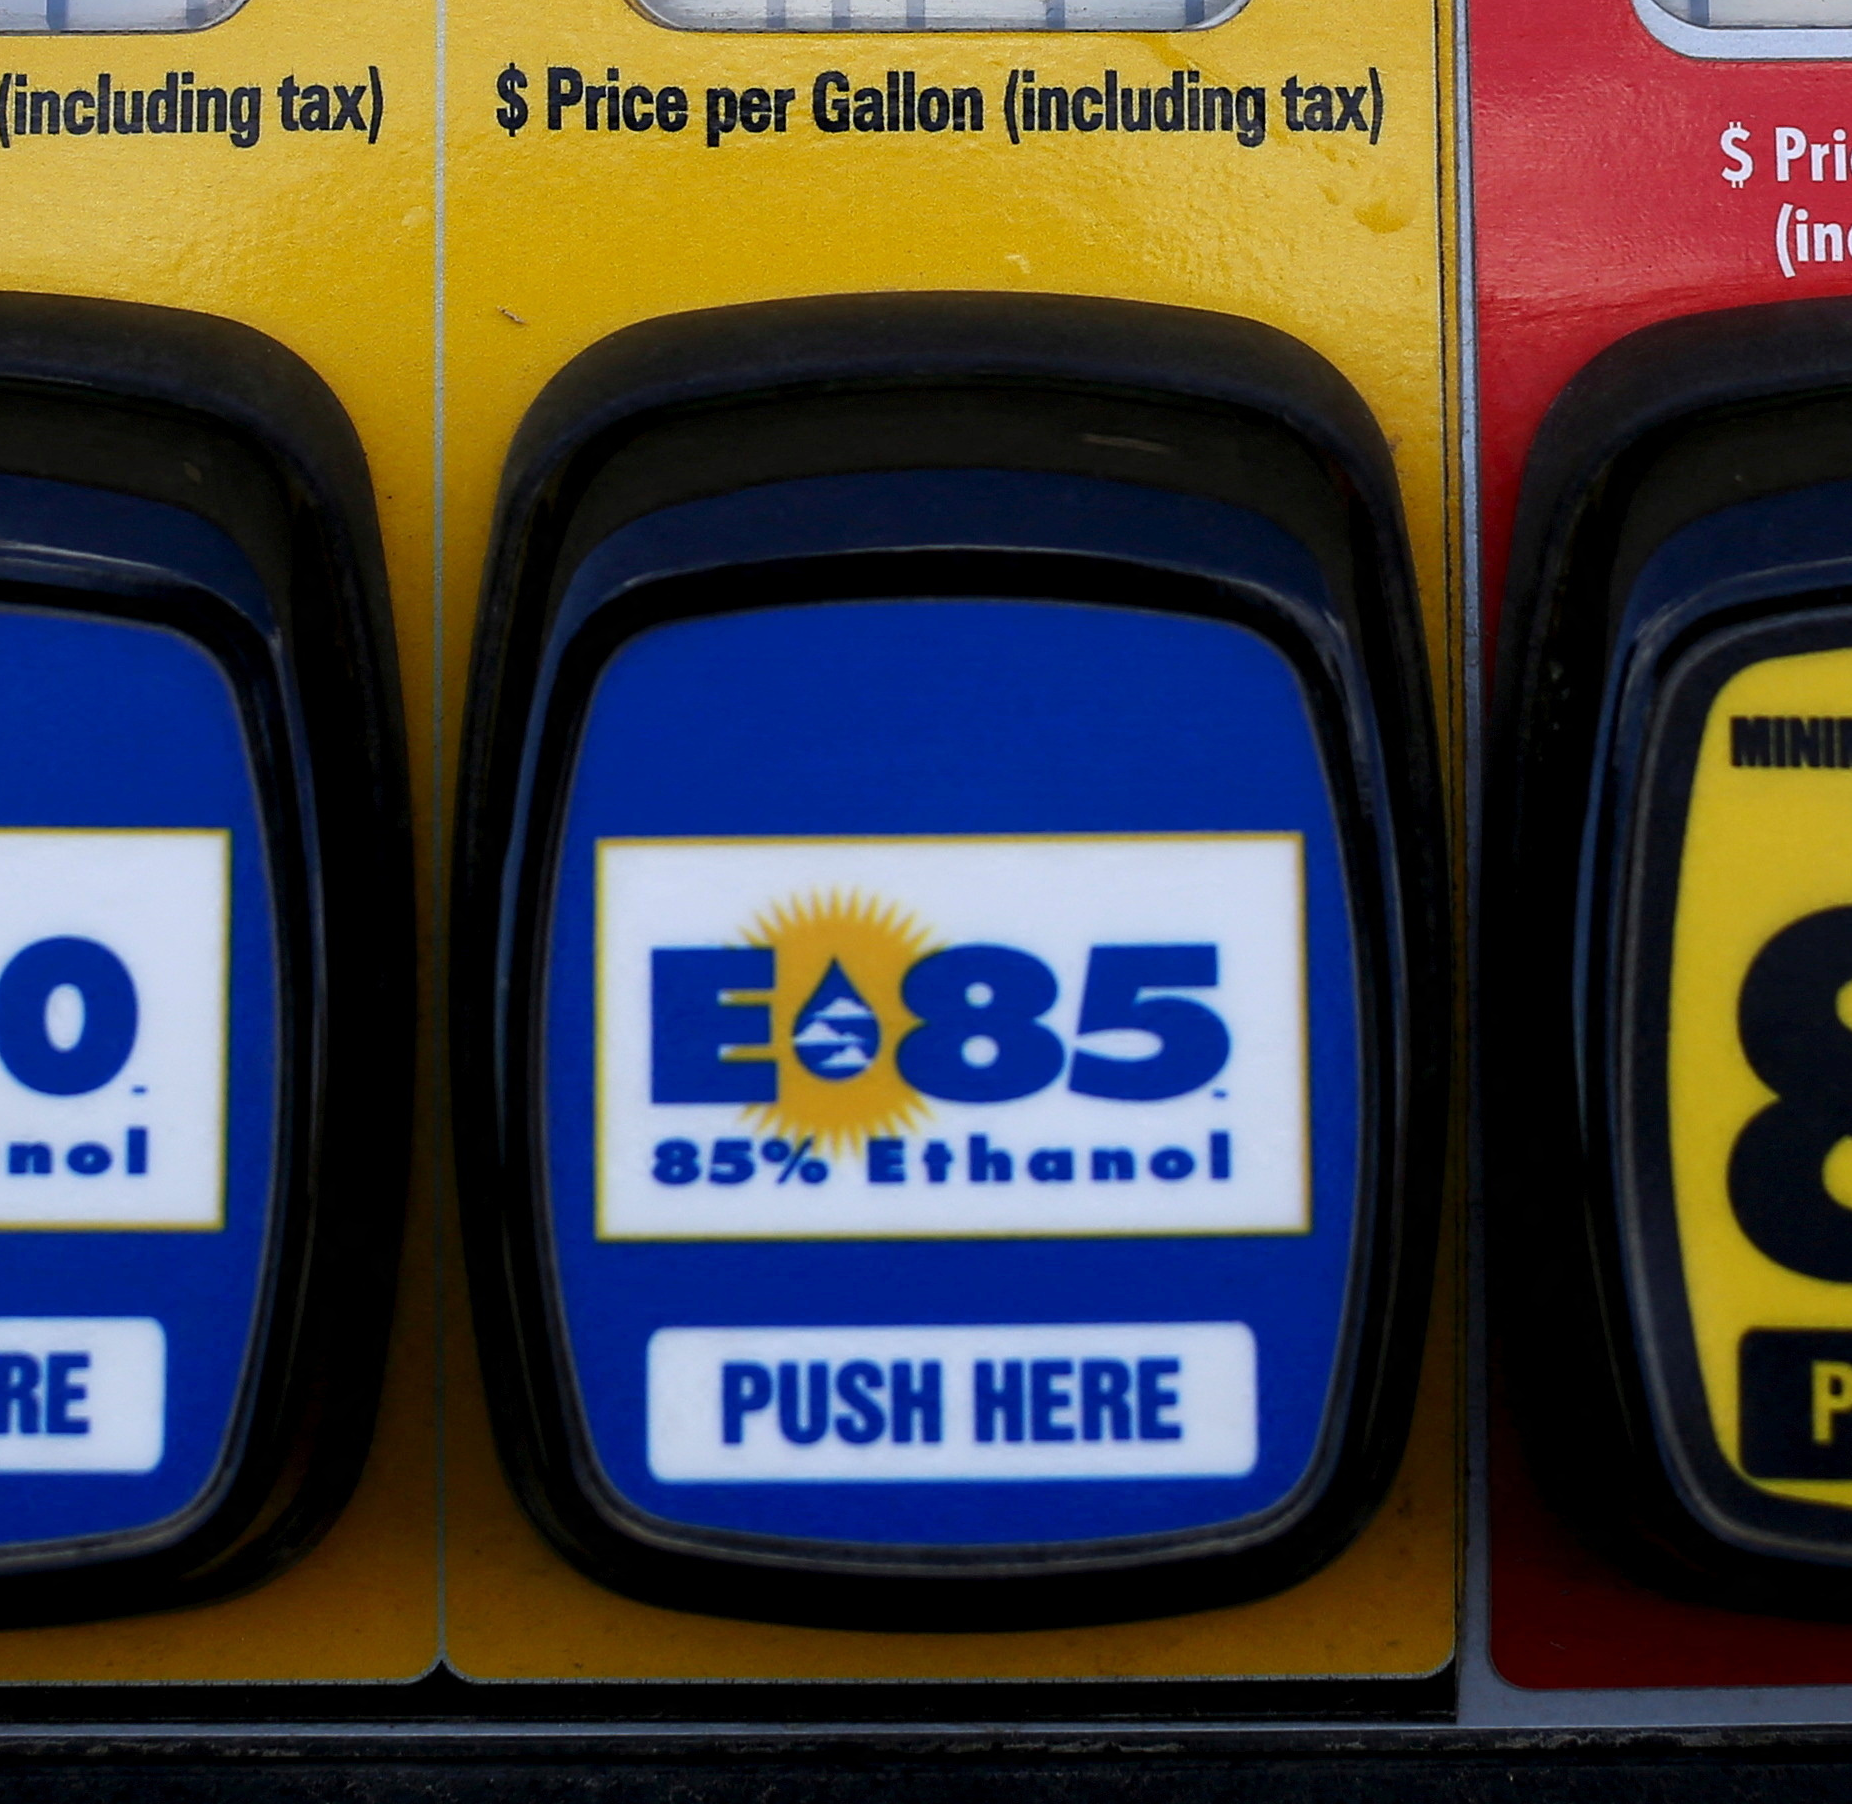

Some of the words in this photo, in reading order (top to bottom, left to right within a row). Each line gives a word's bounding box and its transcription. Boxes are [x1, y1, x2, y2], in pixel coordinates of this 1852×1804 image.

[279, 65, 384, 145] tax)
[496, 62, 529, 136] $
[548, 67, 688, 132] Price
[706, 81, 794, 147] per
[812, 69, 983, 134] Gallon
[1004, 69, 1266, 148] (including
[1282, 67, 1383, 145] tax)
[1721, 122, 1754, 189] $
[651, 1138, 829, 1186] 85%
[866, 1132, 1232, 1184] Ethanol
[720, 1360, 943, 1447] PUSH
[973, 1357, 1182, 1443] HERE
